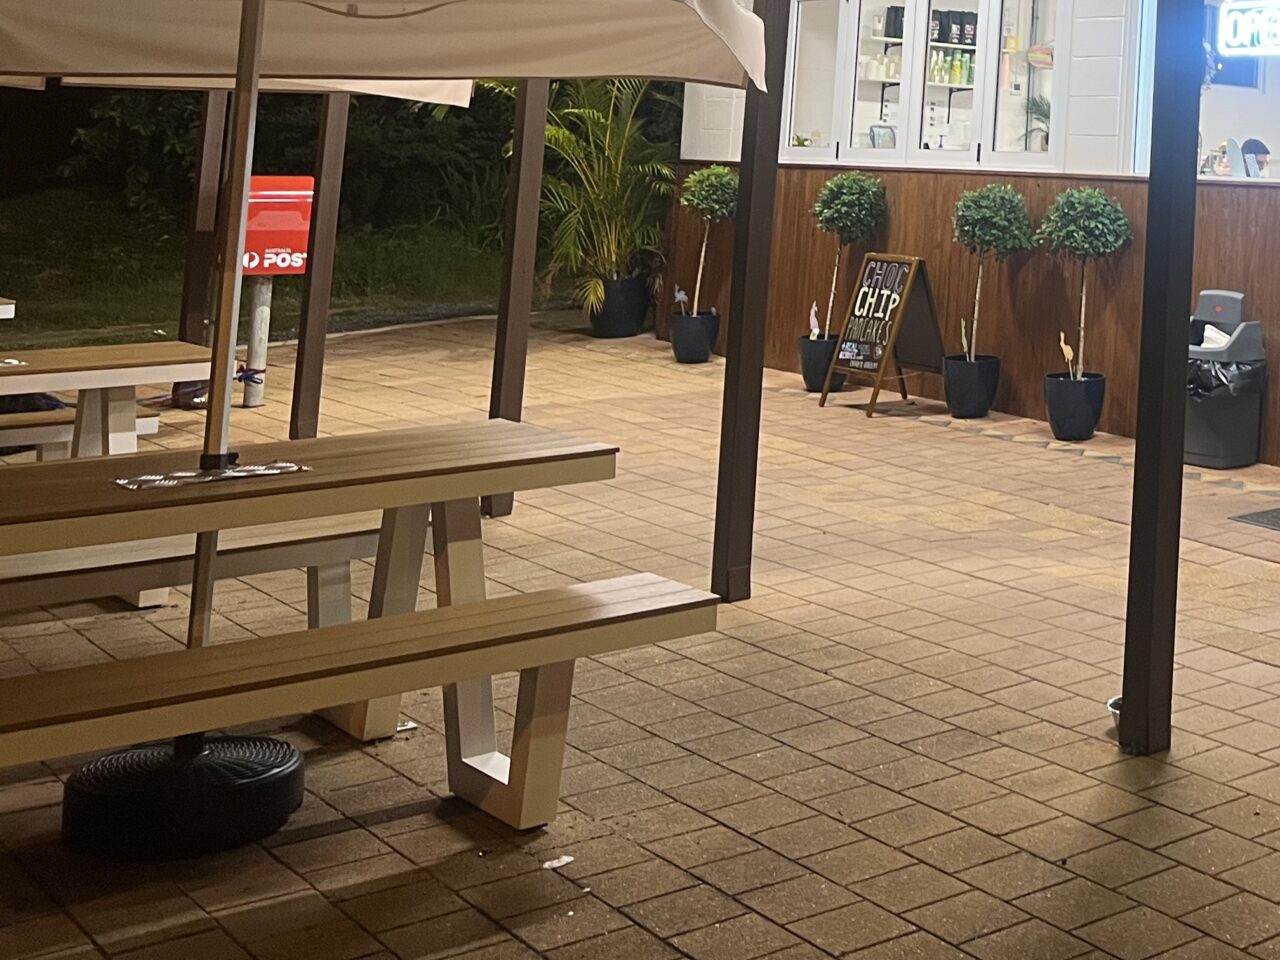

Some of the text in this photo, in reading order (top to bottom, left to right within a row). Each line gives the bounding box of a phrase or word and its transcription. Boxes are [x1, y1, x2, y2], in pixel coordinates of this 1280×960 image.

[862, 260, 910, 295] CHOC
[854, 286, 901, 322] CHIP
[845, 315, 893, 346] PANCAKES
